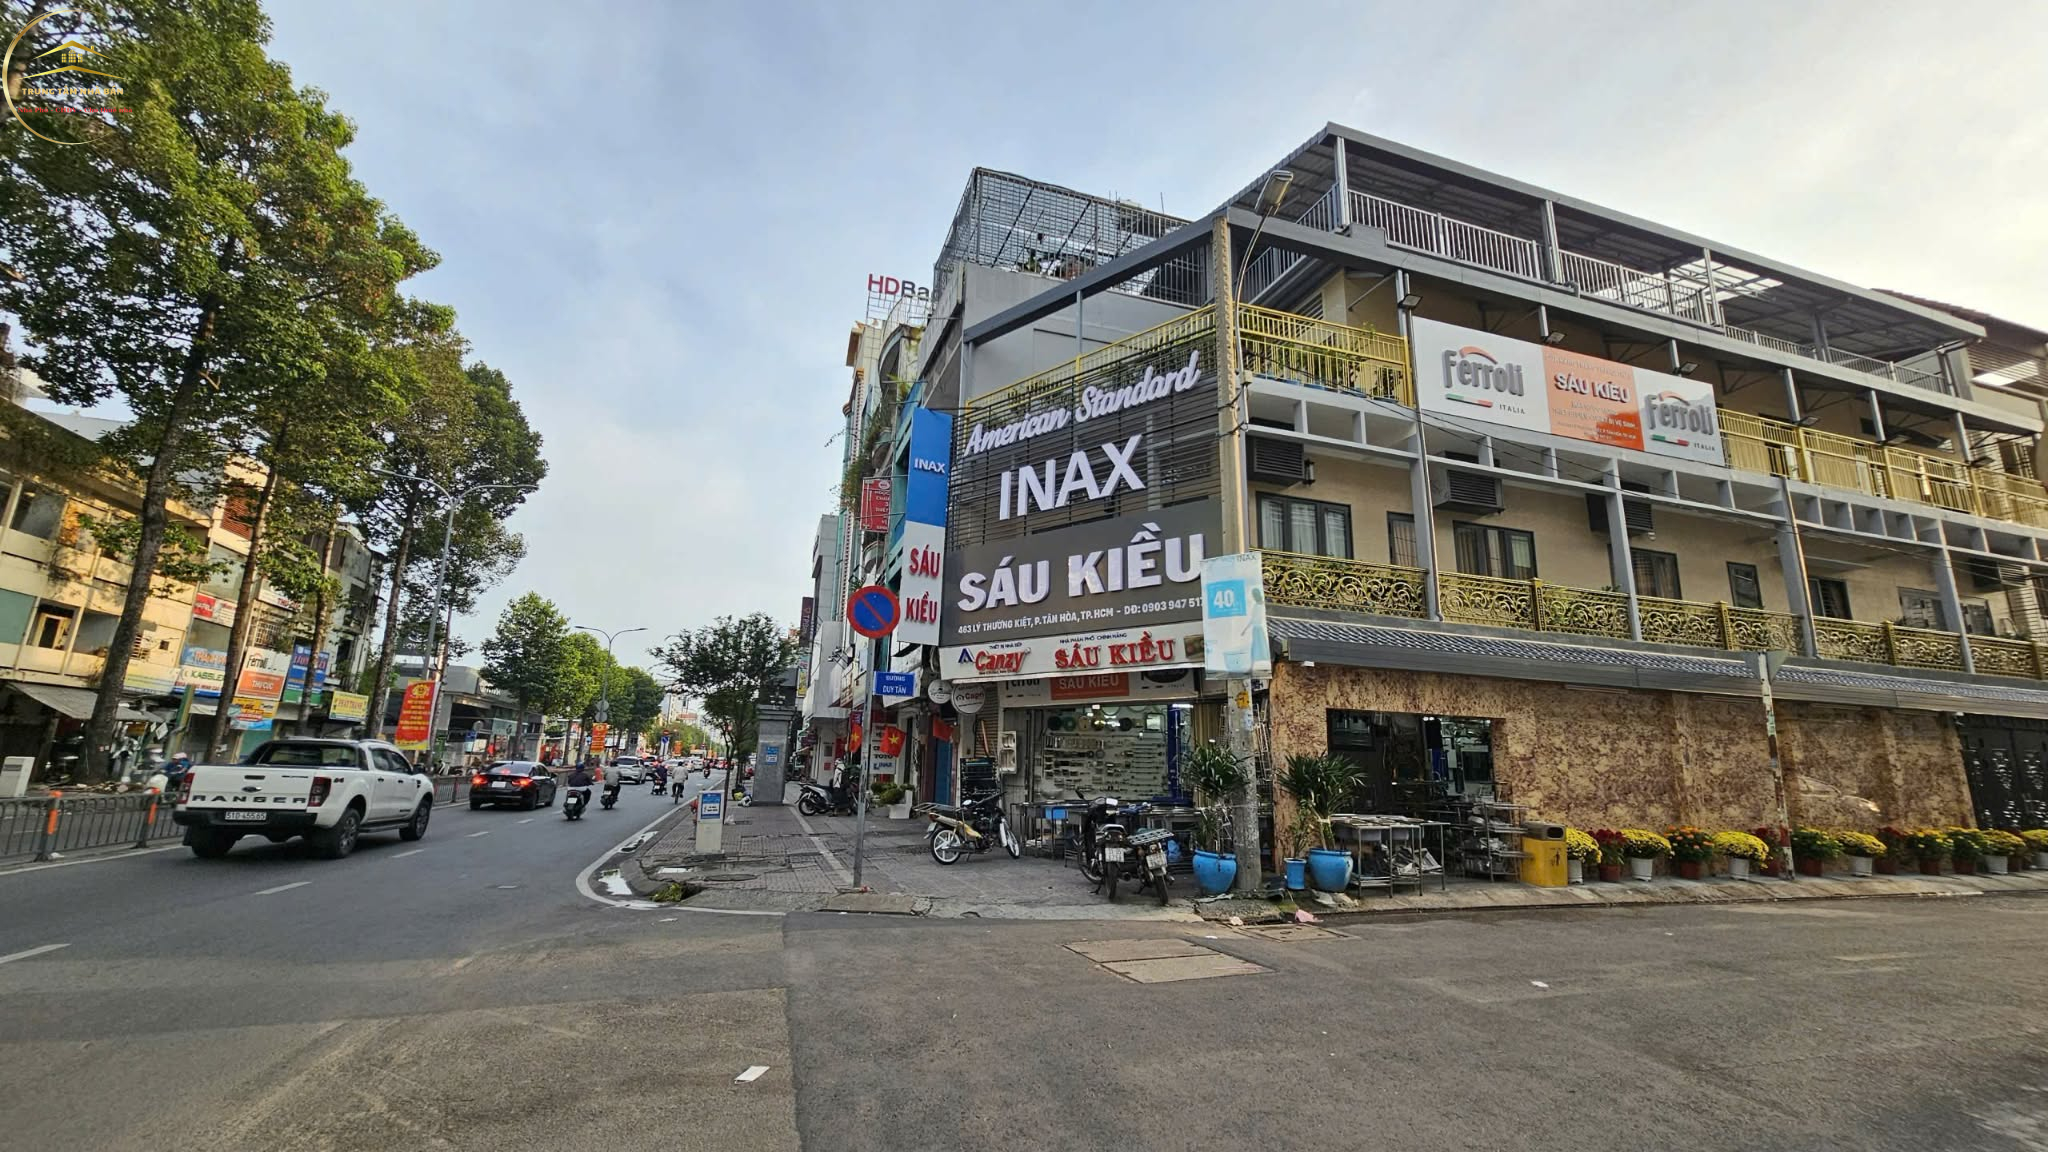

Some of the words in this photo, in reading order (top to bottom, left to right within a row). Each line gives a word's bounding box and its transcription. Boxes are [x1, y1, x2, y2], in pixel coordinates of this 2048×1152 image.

[867, 273, 930, 301] HDBa
[1442, 346, 1524, 396] Ferroli
[1554, 372, 1589, 395] SÁU
[964, 406, 1071, 457] American
[1075, 350, 1202, 424] Standard
[1499, 403, 1526, 414] ITALIA
[1644, 391, 1714, 435] Ferroli
[1694, 442, 1716, 452] ITALIA
[914, 457, 946, 474] INAX
[998, 434, 1146, 521] INAX
[909, 544, 941, 577] SÁU
[958, 555, 1050, 612] SÁU
[1068, 522, 1204, 597] KIỀU
[1237, 553, 1257, 563] INAX
[905, 591, 938, 624] KIỀU
[1213, 590, 1235, 609] 40
[958, 626, 972, 634] 463
[972, 623, 981, 633] LÝ
[1014, 616, 1034, 629] KIỆT,
[1059, 610, 1080, 623] HÒA,
[1124, 605, 1141, 615] DĐ:
[1142, 601, 1167, 613] 0903
[1168, 599, 1187, 610] 947
[975, 650, 1026, 673] Canzy
[1054, 642, 1101, 669] SÁU
[1108, 631, 1176, 665] KIỀU
[882, 685, 894, 694] DUY
[895, 684, 907, 694] TÂN
[192, 795, 306, 804] RANGER
